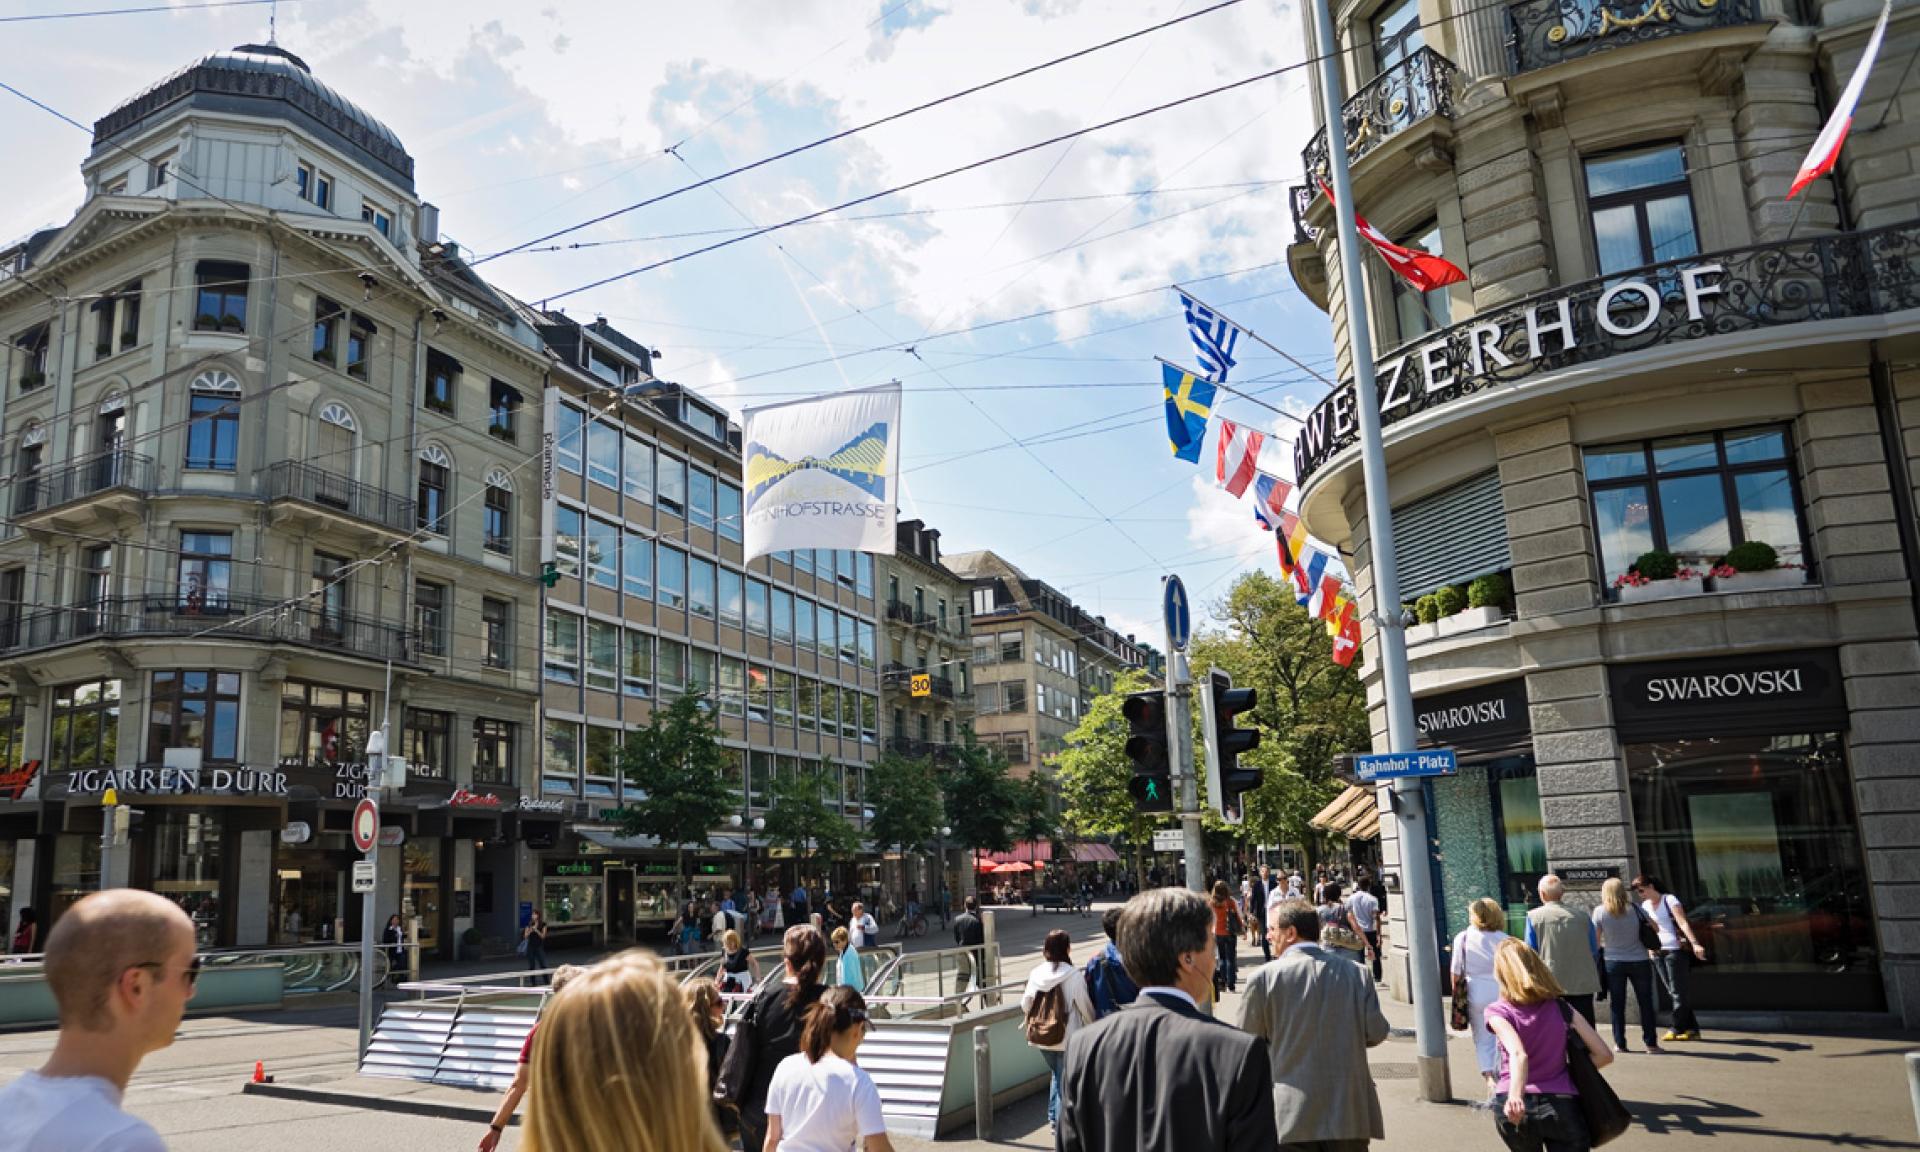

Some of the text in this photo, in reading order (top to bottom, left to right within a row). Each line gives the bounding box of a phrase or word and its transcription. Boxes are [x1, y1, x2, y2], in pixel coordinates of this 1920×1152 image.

[1295, 264, 1723, 478] HWEZERHOF
[912, 678, 930, 692] 30
[1647, 668, 1802, 702] SWAROVSKI
[1418, 698, 1506, 734] SWAROVSKI
[67, 768, 197, 793] ZIGARREN
[211, 766, 289, 793] DÜRR
